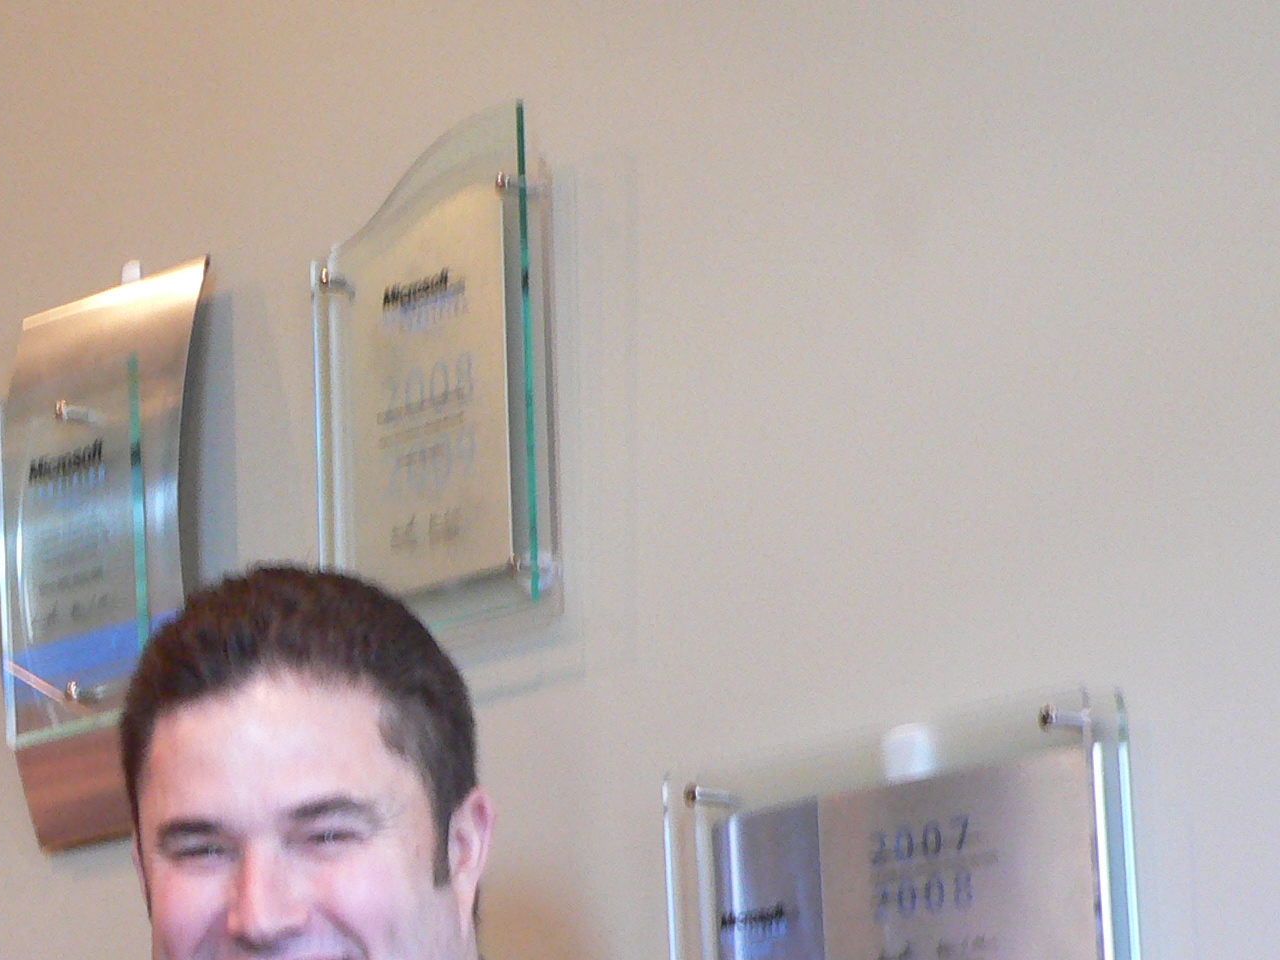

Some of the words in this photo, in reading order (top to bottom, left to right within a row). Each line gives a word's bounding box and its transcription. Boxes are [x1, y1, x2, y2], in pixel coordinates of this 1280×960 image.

[382, 352, 475, 424] 2008
[29, 437, 103, 484] Microsoft
[872, 814, 969, 866] 2007
